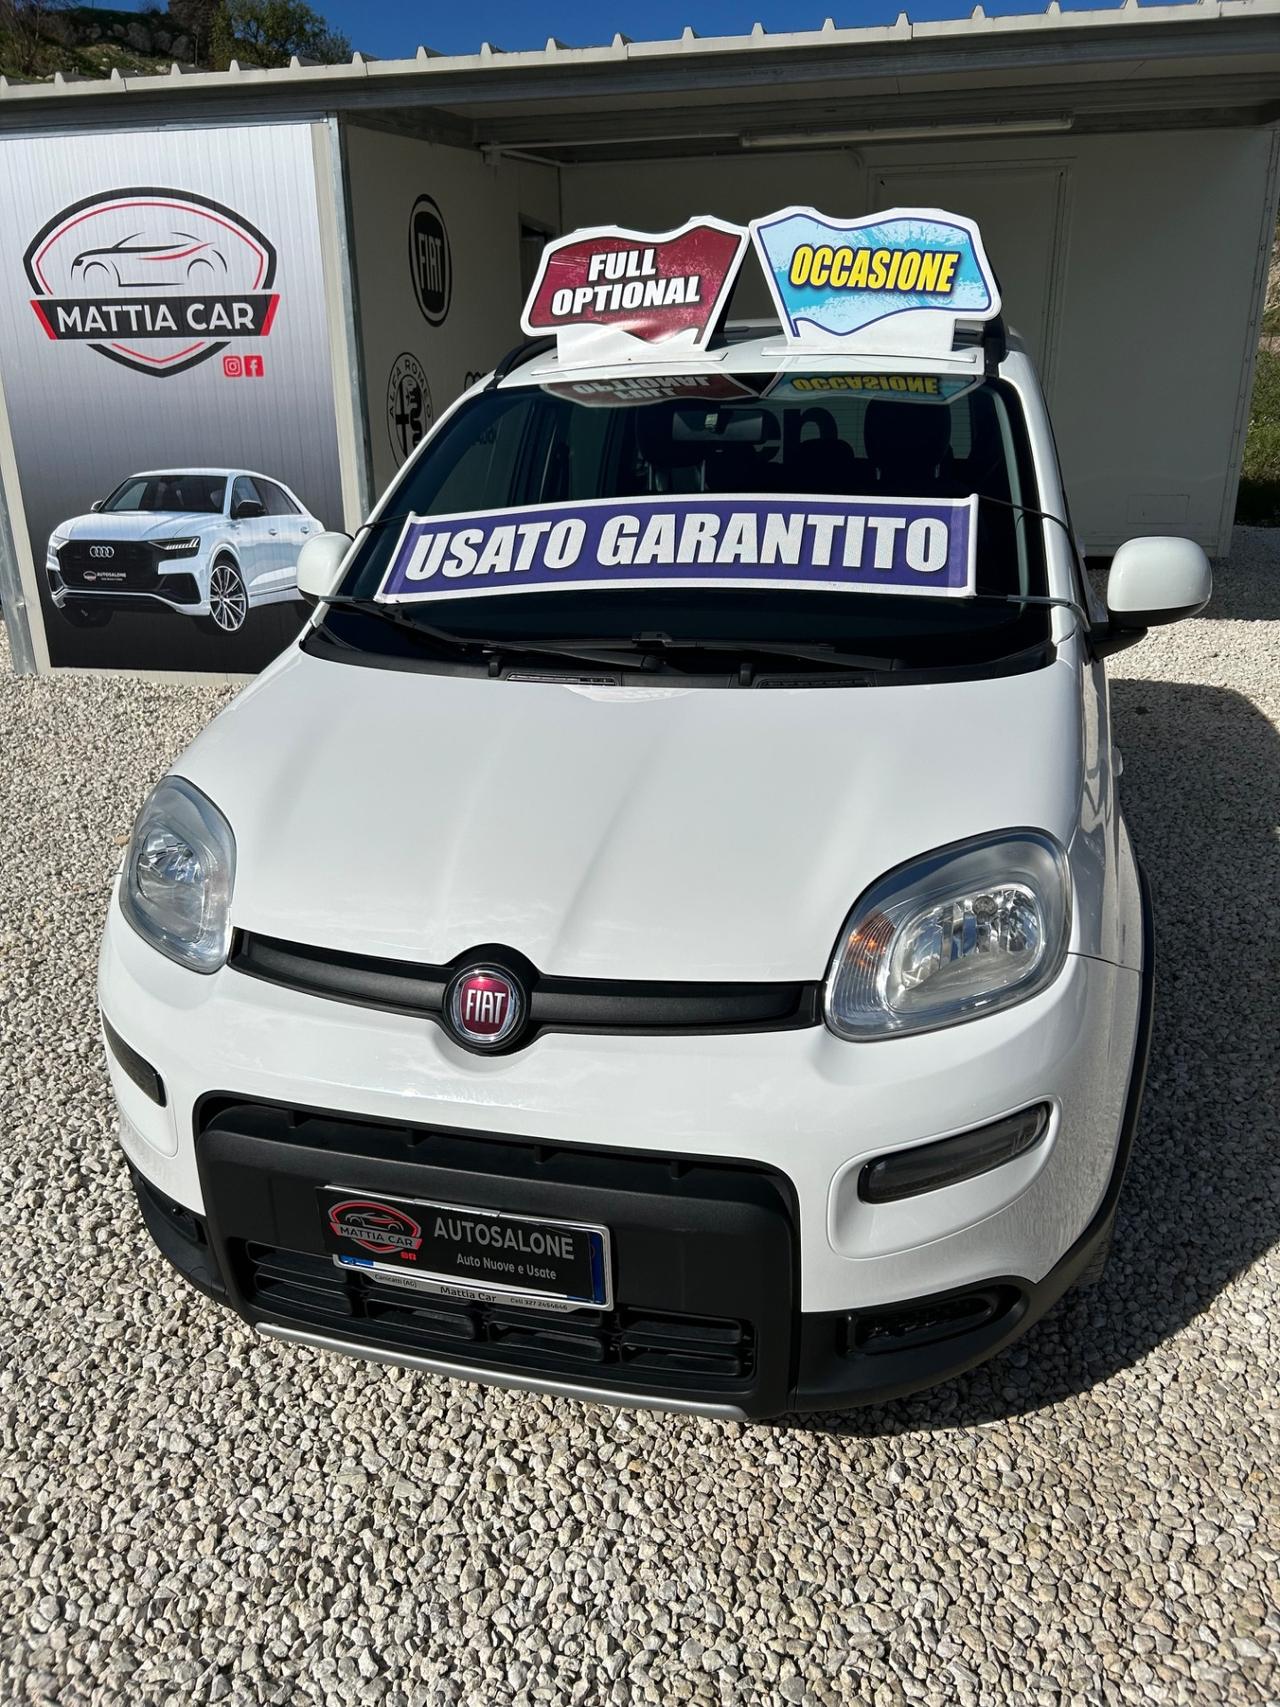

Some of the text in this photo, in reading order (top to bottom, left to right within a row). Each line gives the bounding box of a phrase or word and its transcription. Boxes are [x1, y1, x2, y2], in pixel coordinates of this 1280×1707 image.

[418, 233, 443, 293] FIAT
[588, 249, 656, 282] FULL
[789, 246, 959, 293] OCCASIONE
[551, 276, 700, 316] OPTIONAL
[56, 302, 255, 333] MATTIA CAR
[389, 366, 402, 418] ALFA
[404, 513, 949, 581] USATO GARANTITO
[465, 989, 506, 1024] FIAT
[340, 1226, 413, 1247] MATTIA CAR
[433, 1217, 575, 1260] AUTOSALONE
[457, 1253, 557, 1280] Auto Nuove e Usate
[440, 1286, 497, 1303] Mattia Car
